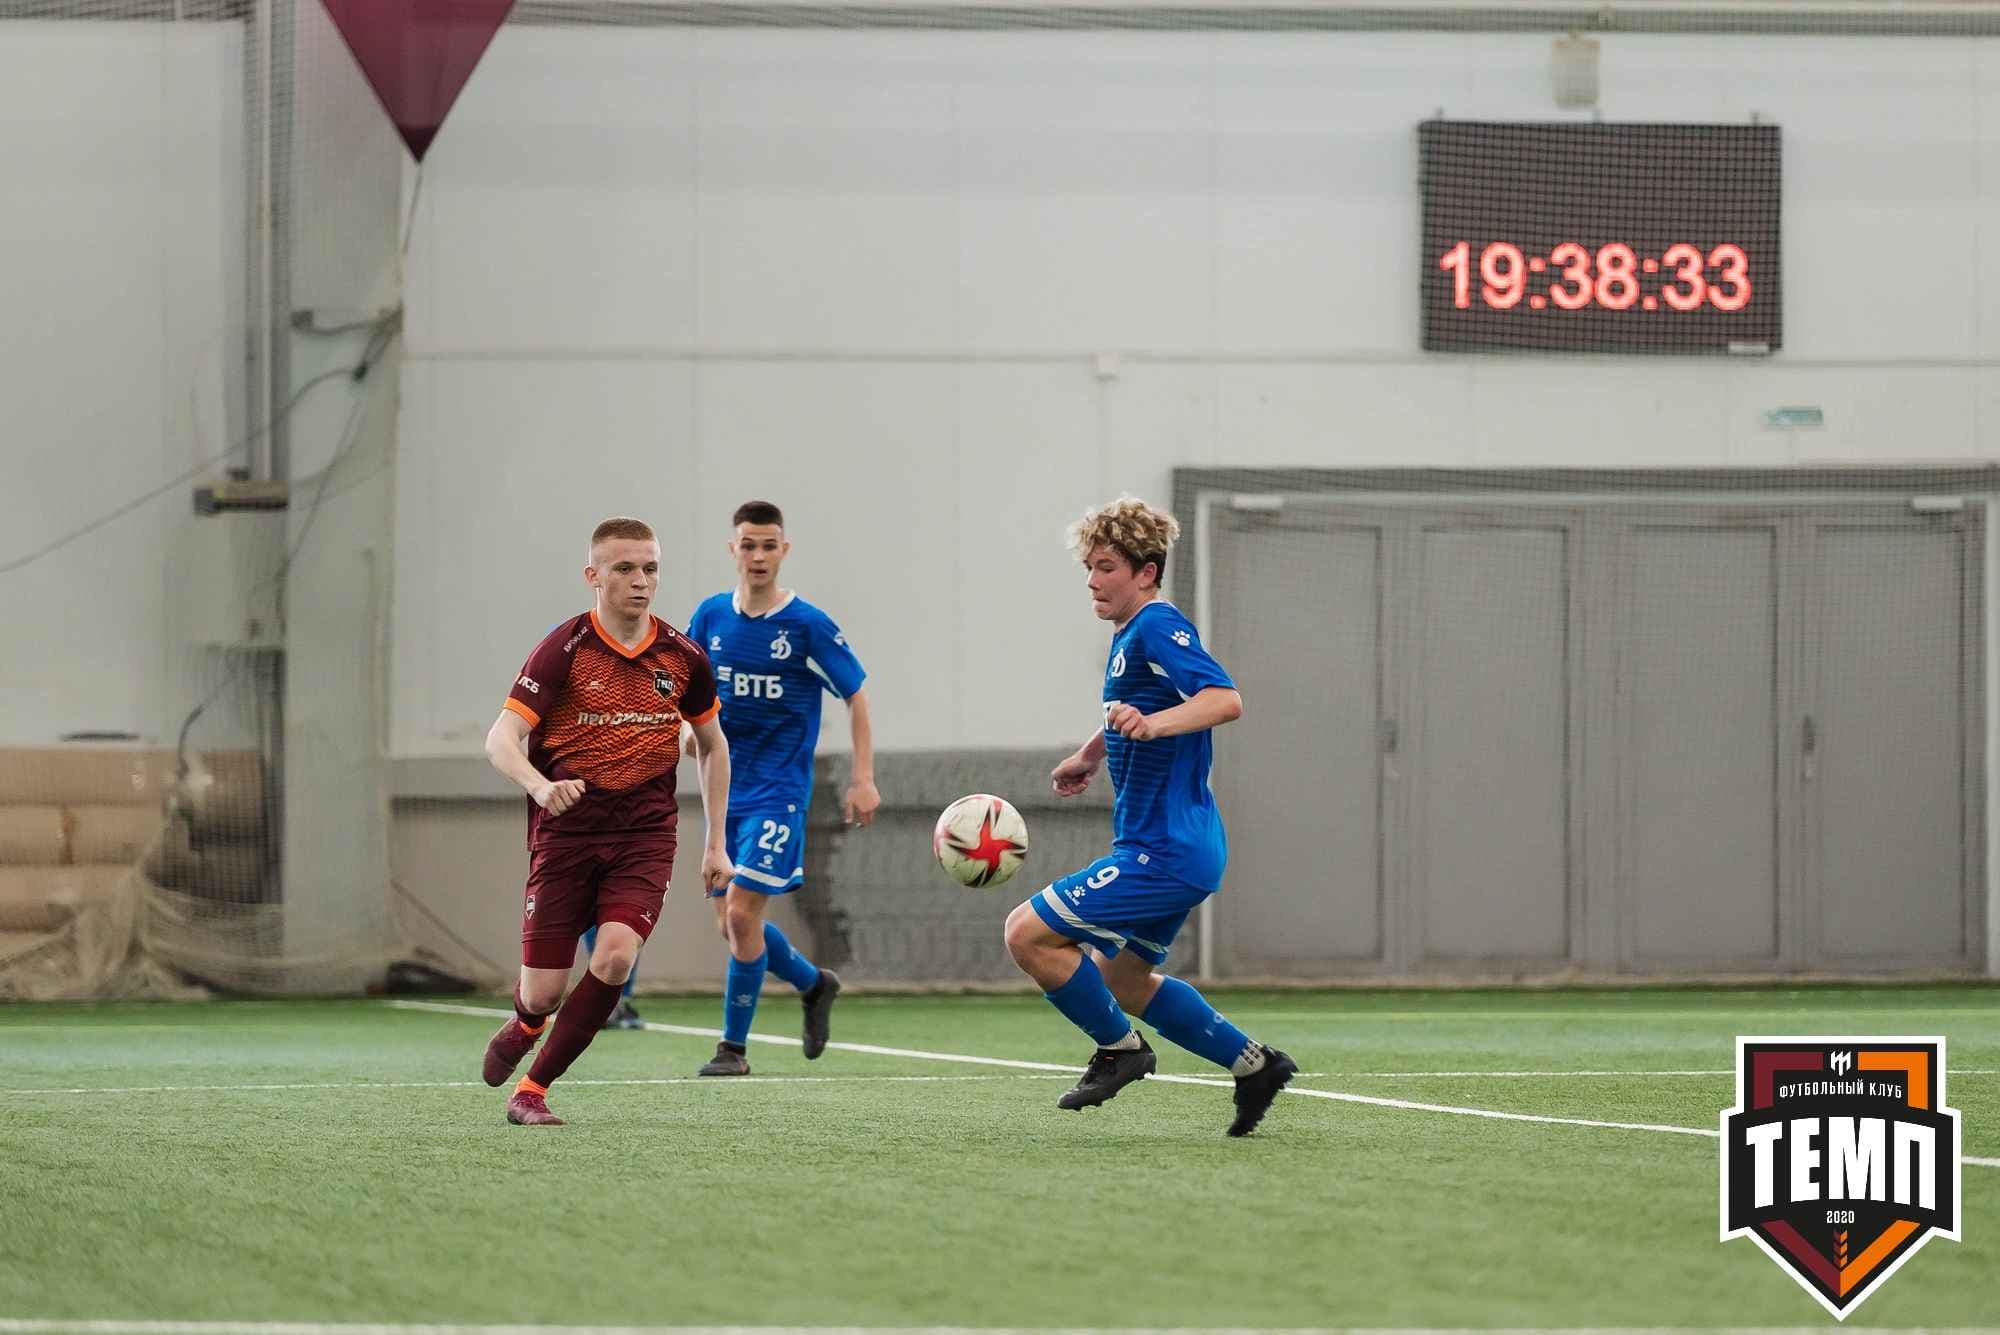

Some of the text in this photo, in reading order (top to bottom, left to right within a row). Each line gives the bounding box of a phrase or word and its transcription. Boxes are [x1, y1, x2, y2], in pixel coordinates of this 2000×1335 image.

[1440, 240, 1751, 311] 19:38:33
[734, 672, 784, 699] ВТБ
[758, 819, 790, 854] 22
[1086, 865, 1120, 889] 9
